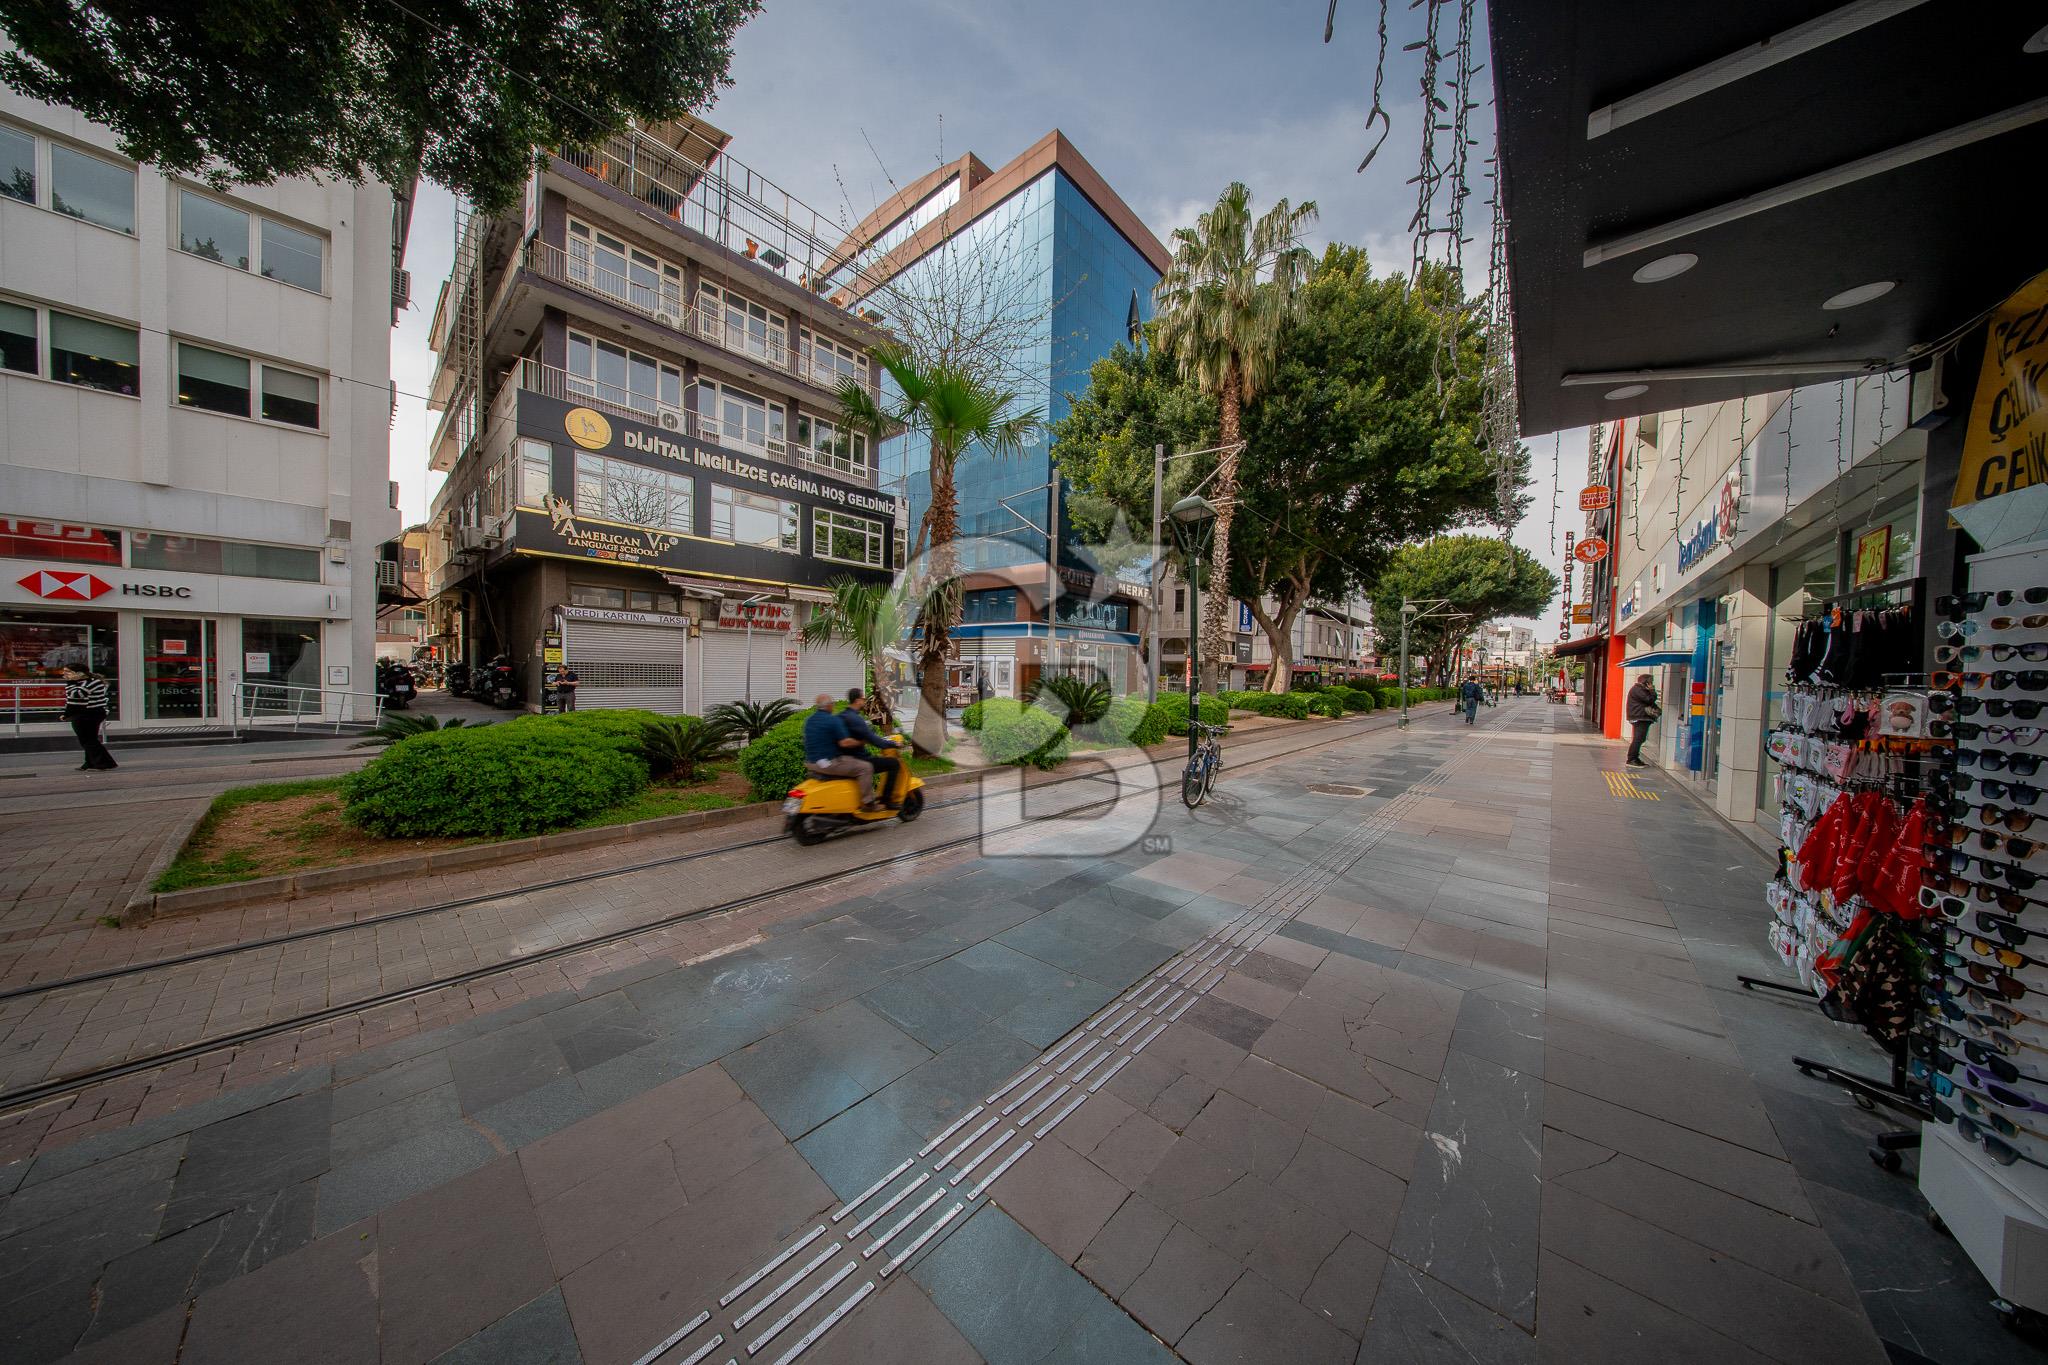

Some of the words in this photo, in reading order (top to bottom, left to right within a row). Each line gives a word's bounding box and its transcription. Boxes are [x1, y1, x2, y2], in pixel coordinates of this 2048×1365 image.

[624, 431, 691, 463] DİJİTAL
[694, 447, 768, 483] İNGİLİZCE
[770, 471, 819, 496] ÇAĞINA
[821, 485, 845, 505] HOŞ
[848, 493, 896, 515] GELDİNİZ
[1581, 492, 1609, 500] BURGER
[1581, 497, 1609, 506] KING
[558, 518, 641, 548] AMERICAN
[567, 537, 619, 552] LANGUAGE
[619, 545, 659, 558] SCHOOLS
[122, 583, 192, 599] HSBC
[1118, 582, 1152, 599] MERKE
[603, 611, 647, 622] KARTINA
